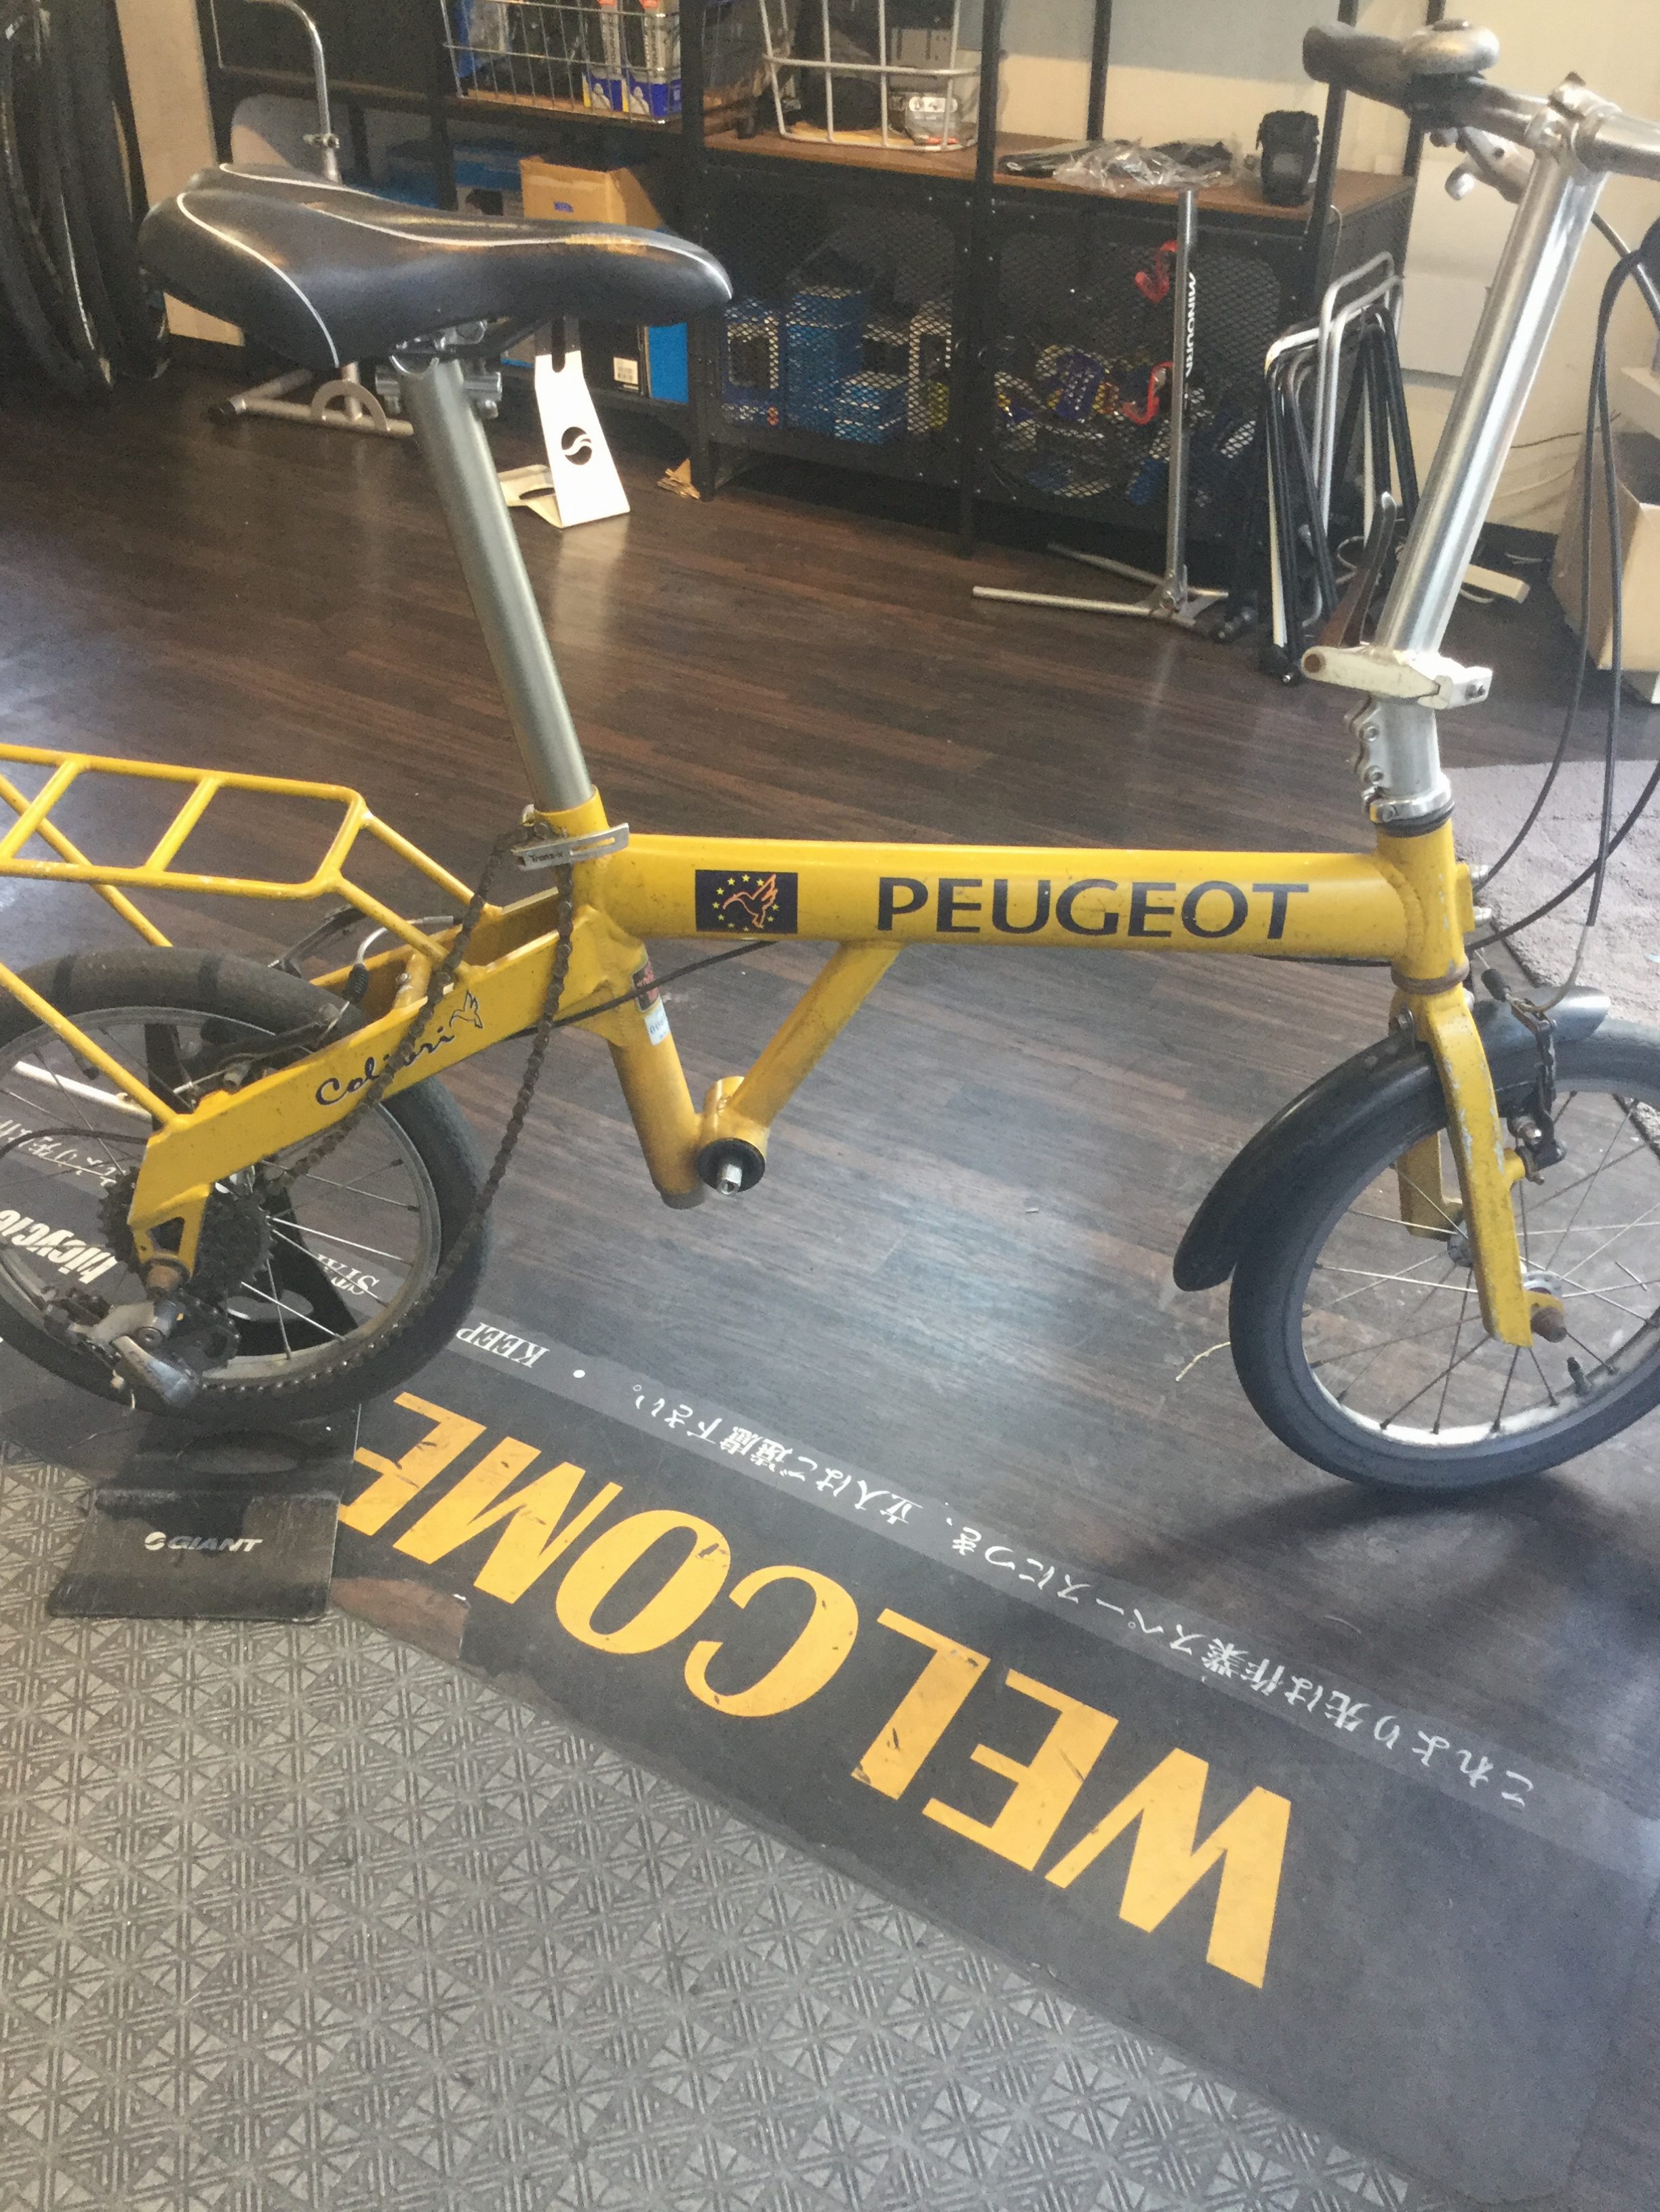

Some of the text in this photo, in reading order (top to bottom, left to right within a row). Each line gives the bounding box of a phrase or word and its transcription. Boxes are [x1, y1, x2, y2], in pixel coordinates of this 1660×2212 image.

[877, 877, 1309, 940] PEUGEOT
[456, 1322, 550, 1368] KEEP
[167, 1535, 264, 1552] GIANT
[338, 1392, 1292, 1989] WELCOME
